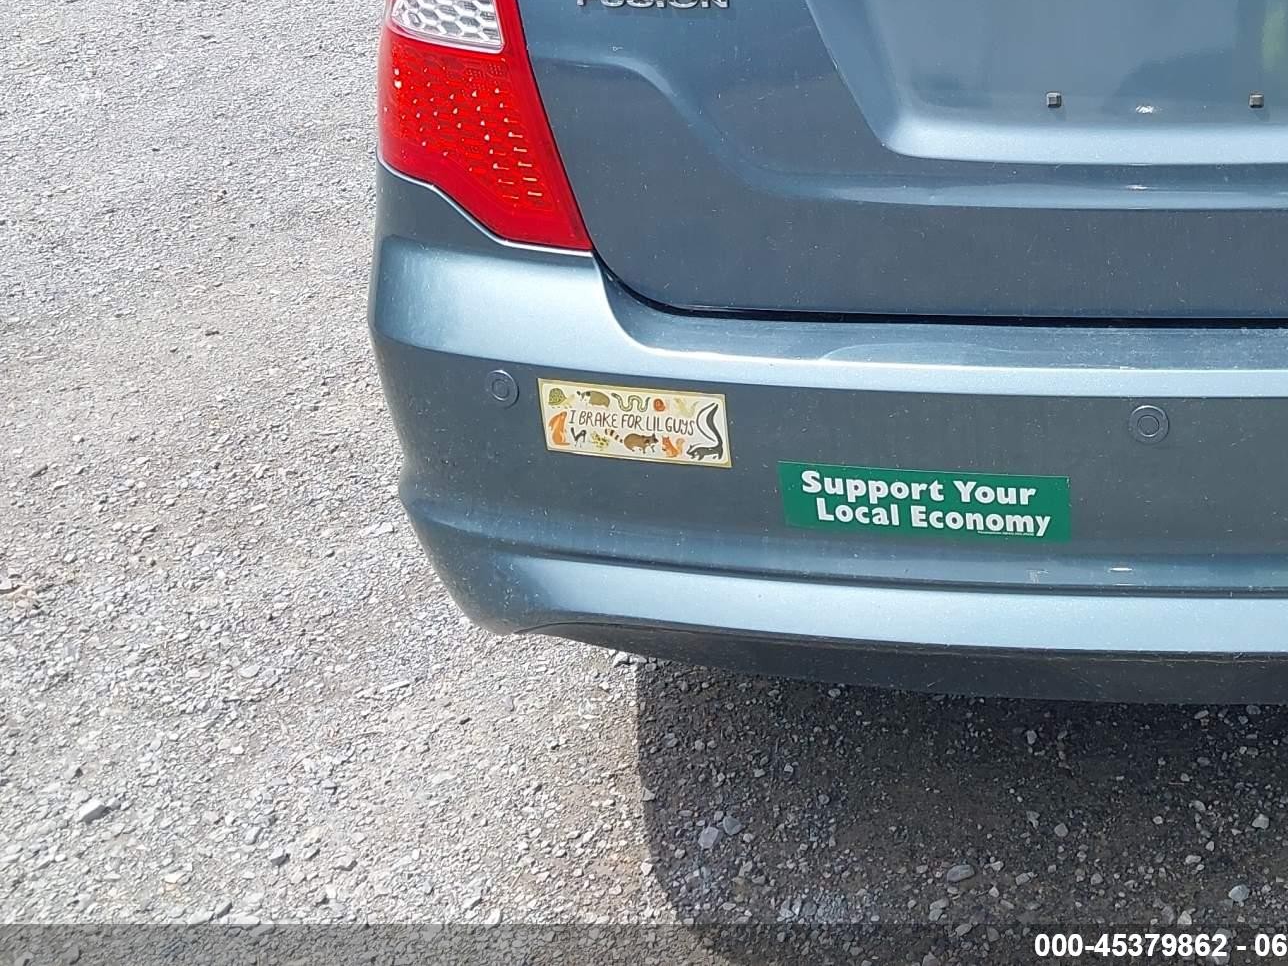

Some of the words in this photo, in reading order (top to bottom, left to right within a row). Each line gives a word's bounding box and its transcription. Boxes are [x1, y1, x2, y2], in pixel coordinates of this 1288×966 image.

[568, 409, 577, 424] I
[578, 409, 619, 429] BRAKE
[621, 413, 646, 431] FOR
[645, 415, 665, 433] LIL
[665, 416, 695, 436] GUYS
[801, 470, 945, 505] Support
[953, 480, 1037, 506] Your
[816, 497, 900, 526] Local
[910, 505, 1052, 537] Economy
